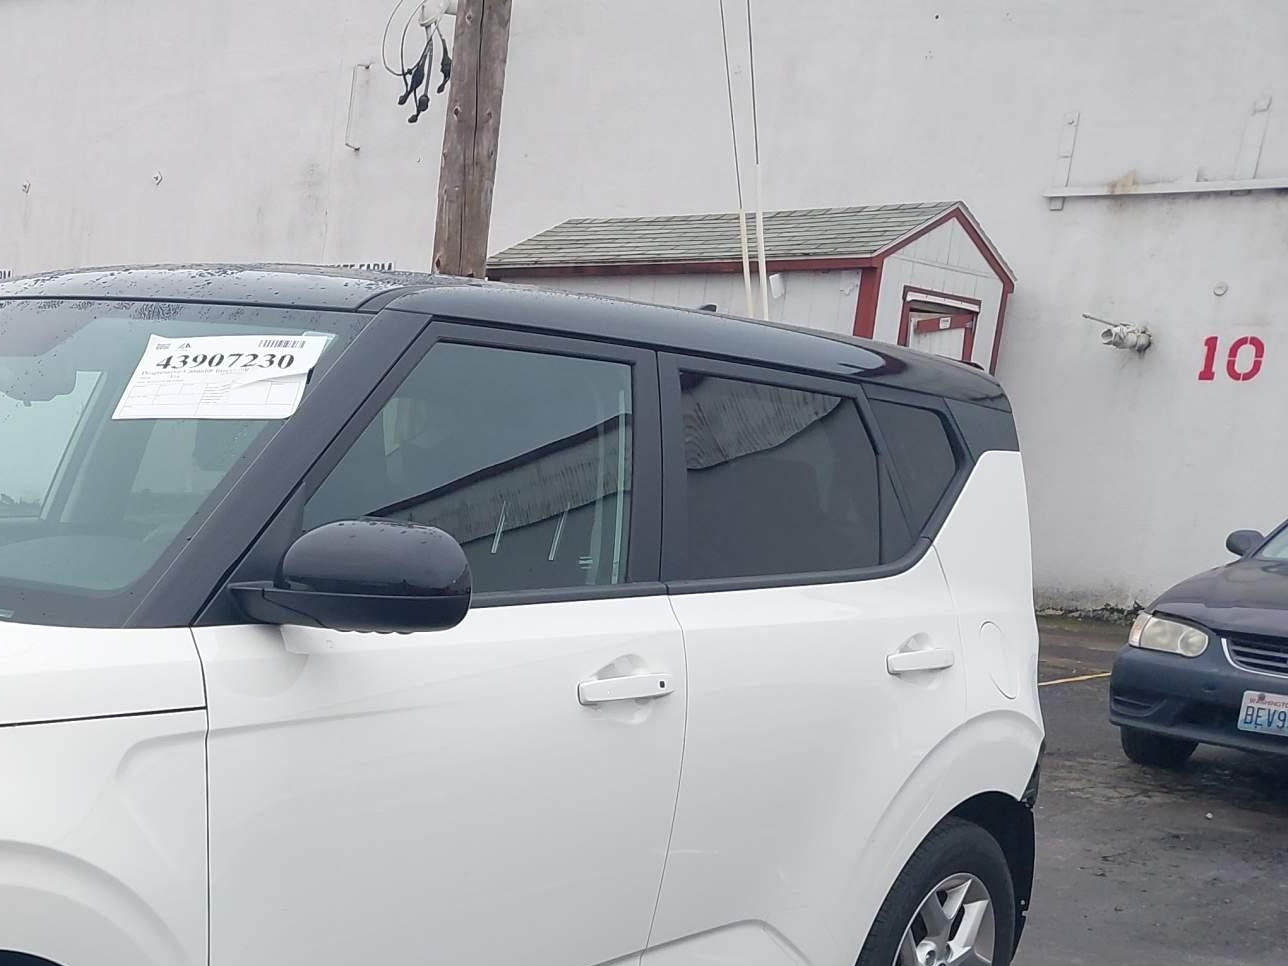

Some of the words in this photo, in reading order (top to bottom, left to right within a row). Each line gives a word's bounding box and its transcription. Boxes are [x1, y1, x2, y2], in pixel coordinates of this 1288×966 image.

[156, 353, 295, 369] 43907230
[1198, 336, 1265, 381] 10
[1243, 705, 1288, 729] BEV9
